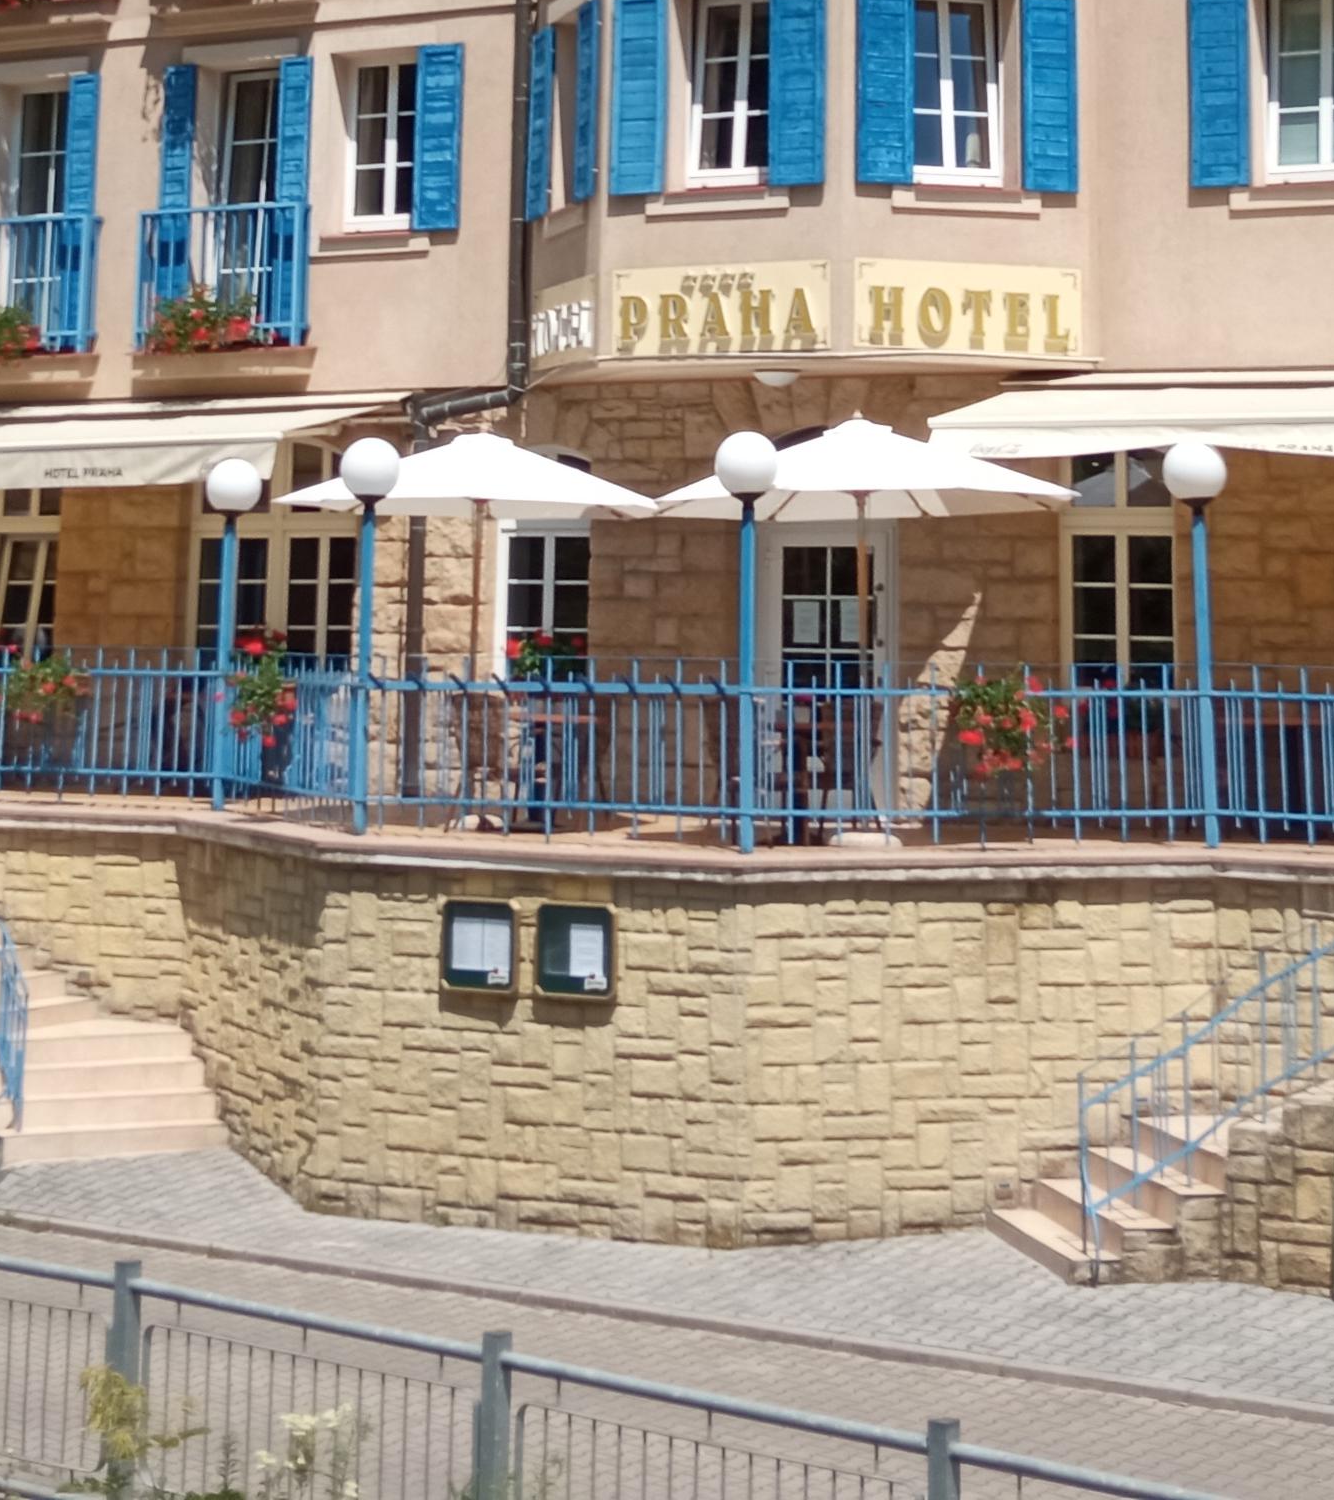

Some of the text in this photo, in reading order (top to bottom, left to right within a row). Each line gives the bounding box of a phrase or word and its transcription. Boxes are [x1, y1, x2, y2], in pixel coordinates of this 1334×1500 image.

[619, 288, 816, 341] PRAHA
[869, 285, 1070, 339] HOTEL
[44, 467, 123, 479] HOTEL PRAHA
